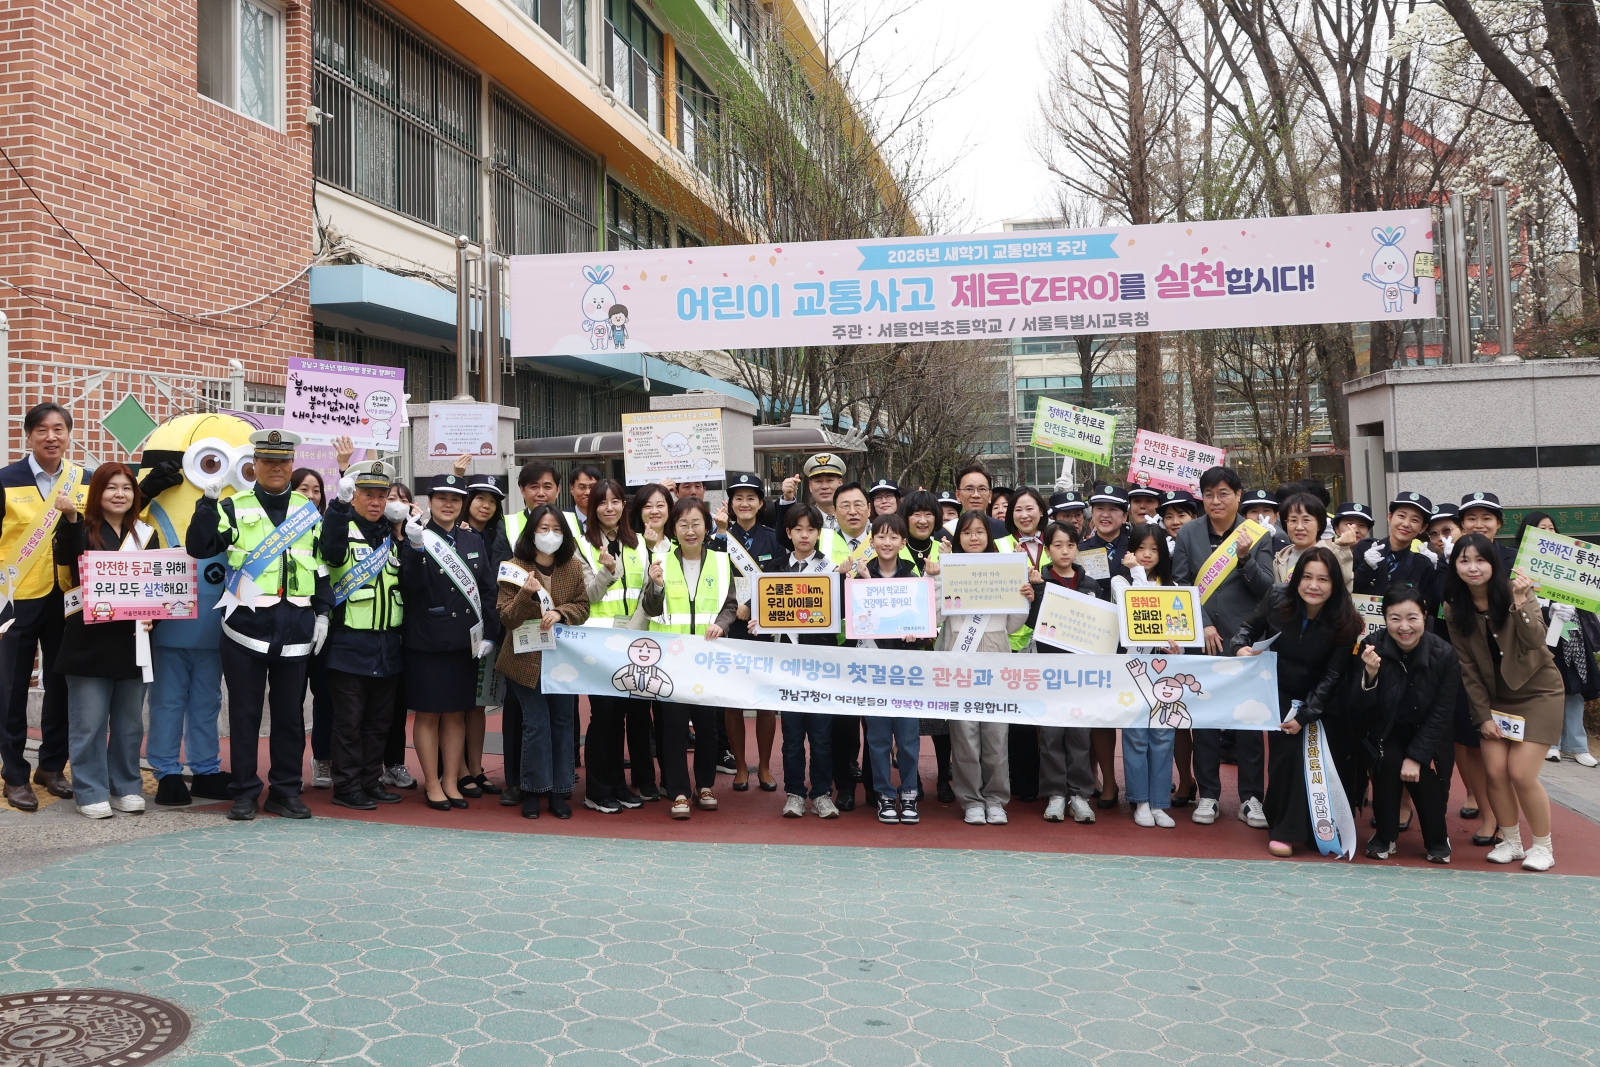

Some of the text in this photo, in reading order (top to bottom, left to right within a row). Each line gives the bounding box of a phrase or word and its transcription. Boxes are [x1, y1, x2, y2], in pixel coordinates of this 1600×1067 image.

[888, 239, 1087, 264] 2026년 새학기 교통안전 주간
[676, 260, 1315, 321] 어린이 교통사고 제로(ZERO)를 실천합시다!
[1387, 290, 1398, 298] 30
[595, 327, 605, 336] 30
[832, 325, 863, 340] 주관
[877, 319, 1002, 338] 서울언북초등학교
[1022, 312, 1150, 332] 서울특별시교육청
[301, 360, 317, 368] 강남구
[294, 379, 342, 398] 붕어빵엔
[1048, 405, 1105, 431] 정해진 통학로로
[1044, 422, 1076, 439] 안전등교
[1057, 446, 1084, 458] 서울언북초등학교
[1144, 438, 1215, 465] 안전한 등교를 위해
[1139, 456, 1156, 468] 우리
[1157, 460, 1174, 472] 모두
[1538, 539, 1573, 560] 정해진
[96, 562, 186, 576] 안전한 등교를 위해
[1202, 554, 1230, 586] 교통안전
[1530, 558, 1576, 582] 안전등교
[94, 582, 188, 598] 우리 모두 실천해요!
[766, 584, 824, 596] 스쿨존 30km,
[866, 586, 908, 596] 걸어서 학교로!
[1546, 590, 1586, 606] 서울언북초등학교
[768, 597, 822, 608] 우리 아이들의
[863, 597, 912, 609] 건강에도 좋아요!
[1131, 596, 1160, 608] 멈춰요!
[768, 610, 794, 622] 생명선
[1132, 610, 1162, 622] 살펴요!
[564, 630, 587, 640] 강남구
[1134, 624, 1164, 635] 건너요!
[694, 652, 1112, 690] 아동학대 예방의 첫걸음은 관심과 행동입니다!
[779, 688, 1021, 714] 강남구청이 여러분들의 행복한 미래를 응원합니다.
